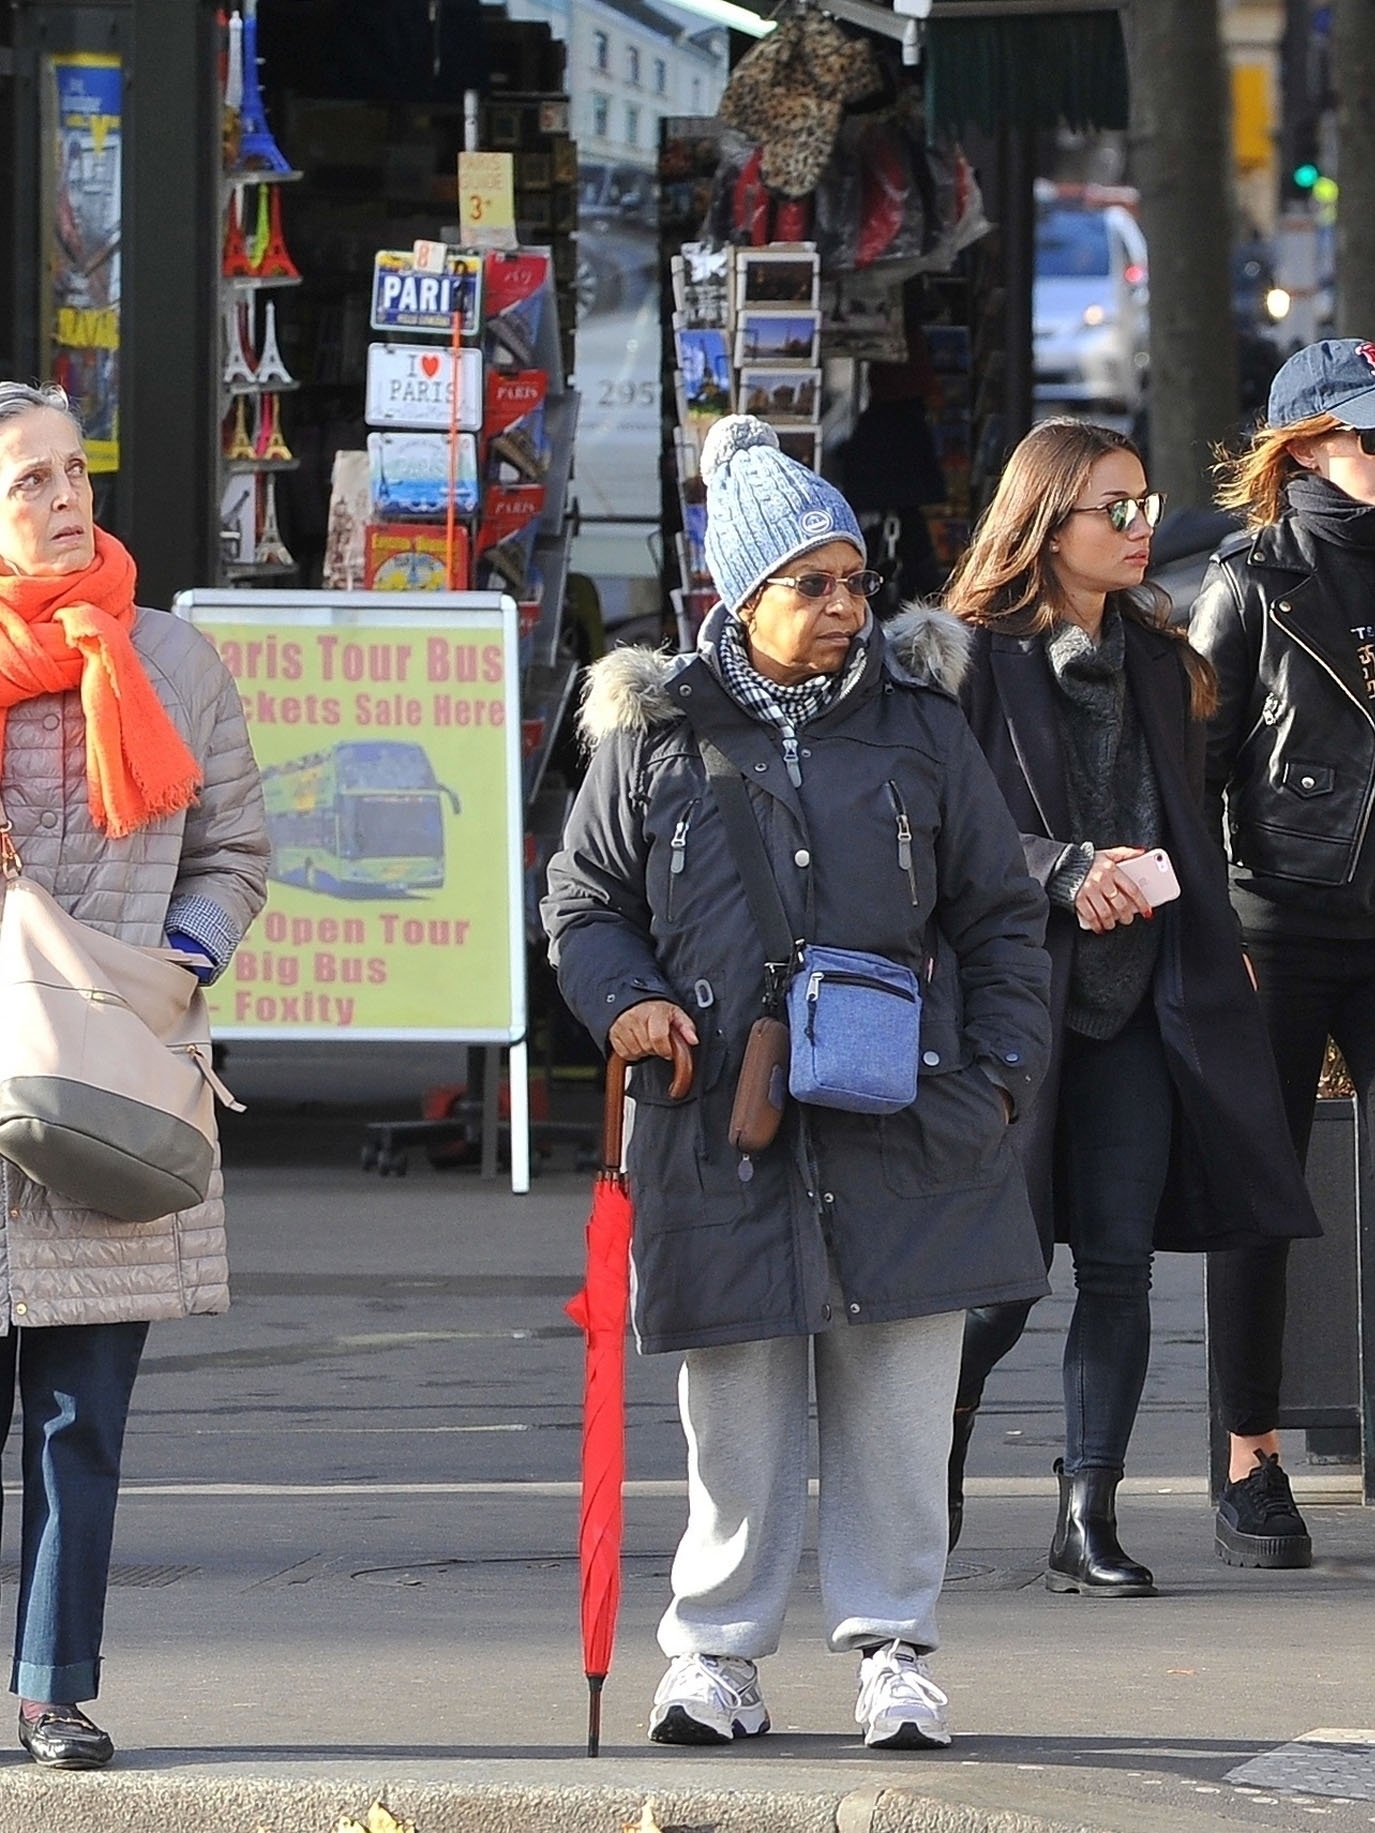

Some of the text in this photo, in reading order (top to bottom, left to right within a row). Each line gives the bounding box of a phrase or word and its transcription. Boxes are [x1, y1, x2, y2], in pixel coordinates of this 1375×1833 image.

[383, 275, 460, 313] PARI
[407, 355, 418, 378] I
[598, 379, 655, 408] 295
[316, 635, 412, 682] Tour
[427, 636, 504, 683] Bus
[355, 692, 422, 727] Sale
[433, 693, 505, 727] Here
[264, 911, 366, 947] Open
[380, 913, 470, 946] Tour
[235, 951, 388, 986] Big Bus
[235, 991, 355, 1027] Foxity
